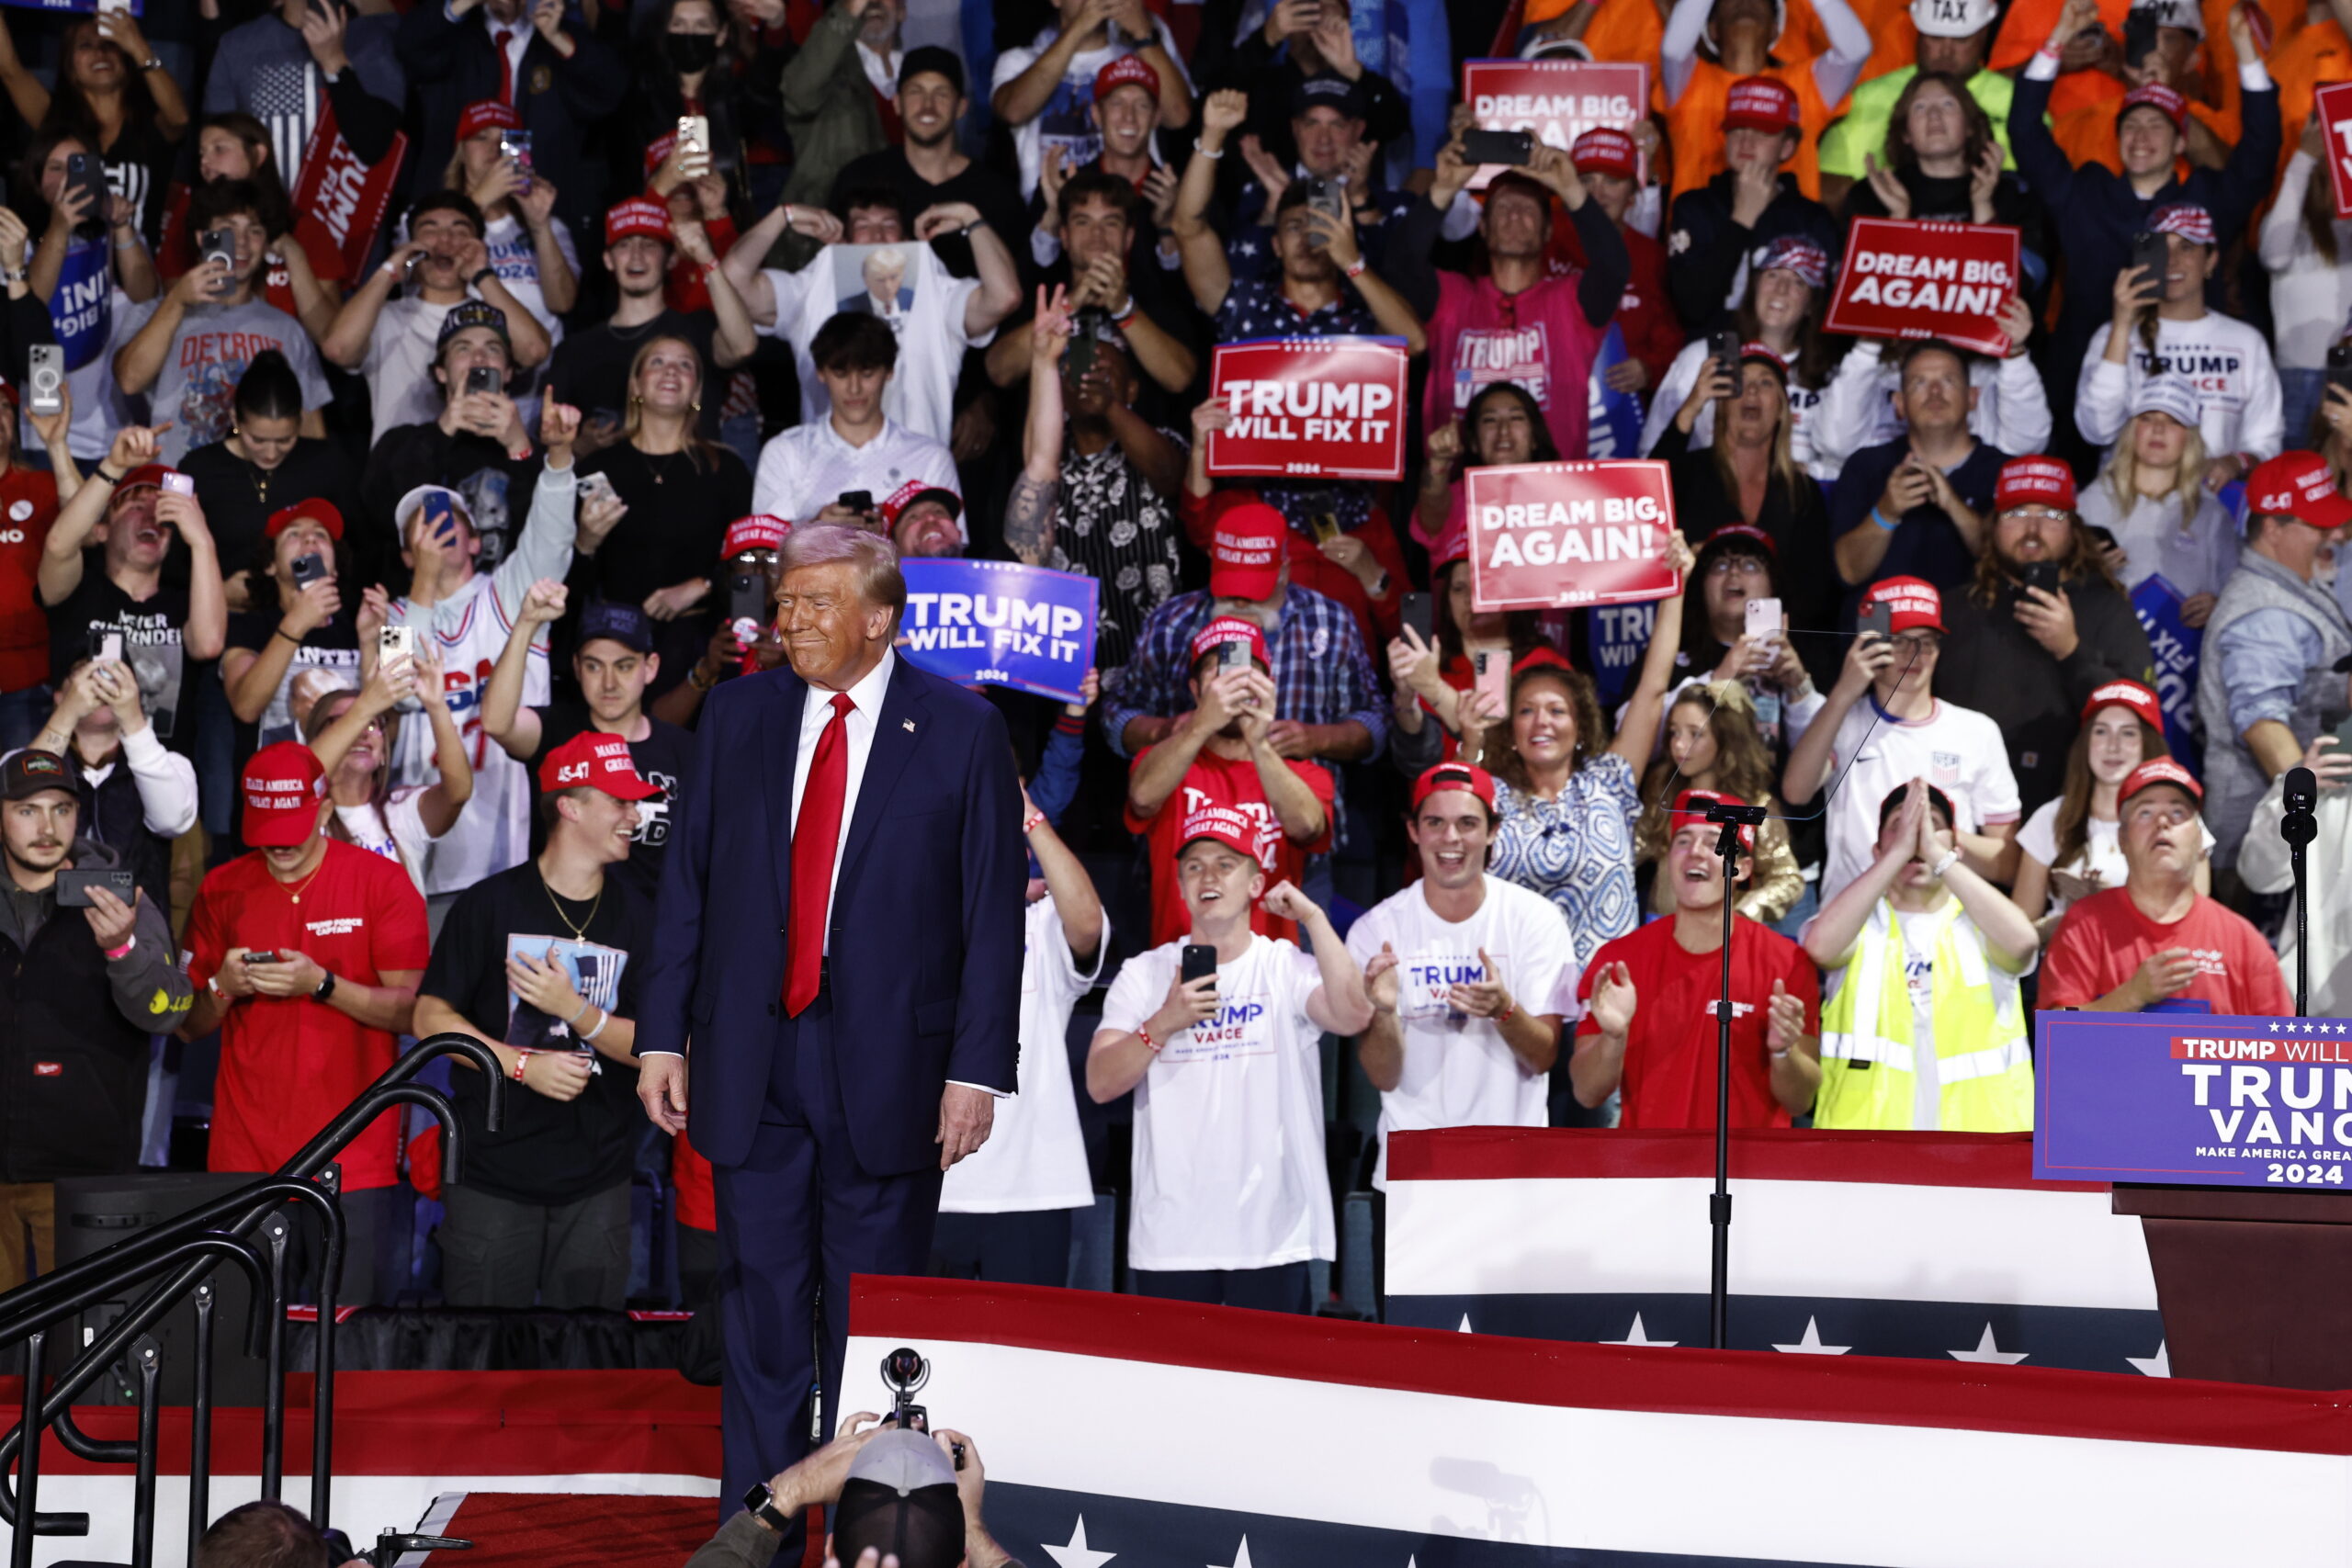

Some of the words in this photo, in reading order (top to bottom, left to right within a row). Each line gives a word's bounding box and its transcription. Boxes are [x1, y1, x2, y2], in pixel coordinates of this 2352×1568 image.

[1930, 2, 1968, 23] TAX
[1475, 94, 1576, 118] DREAM
[1582, 95, 1637, 120] BIG,
[1854, 250, 1959, 281] DREAM
[1962, 258, 2013, 289] BIG,
[1849, 275, 2003, 317] AGAIN!
[1461, 329, 1542, 370] TRUMP
[1222, 378, 1394, 420] TRUMP
[1224, 416, 1298, 441] WILL
[1304, 418, 1354, 443] FIX
[1360, 420, 1390, 444] IT
[1481, 499, 1596, 530] DREAM
[1603, 495, 1668, 525] BIG,
[1488, 524, 1654, 569] AGAIN!
[906, 592, 1083, 638] TRUMP
[1597, 607, 1658, 643] TRU
[290, 646, 360, 666] ANTE
[906, 626, 986, 651] WILL
[993, 628, 1043, 657] FIX
[1050, 637, 1080, 663] IT
[975, 669, 1009, 682] 2024
[558, 761, 590, 783] 45-47
[1410, 965, 1483, 987] TRUM
[1190, 1002, 1263, 1030] UMP
[1193, 1027, 1242, 1044] VANCE
[2182, 1038, 2277, 1060] TRUMP
[2283, 1042, 2349, 1063] WILL
[2181, 1064, 2352, 1111] TRU
[2209, 1108, 2352, 1147] VANC
[2195, 1146, 2236, 1157] MAKE
[2241, 1148, 2307, 1160] AMERICA
[2312, 1150, 2352, 1161] GREA
[2267, 1163, 2344, 1185] 2024
